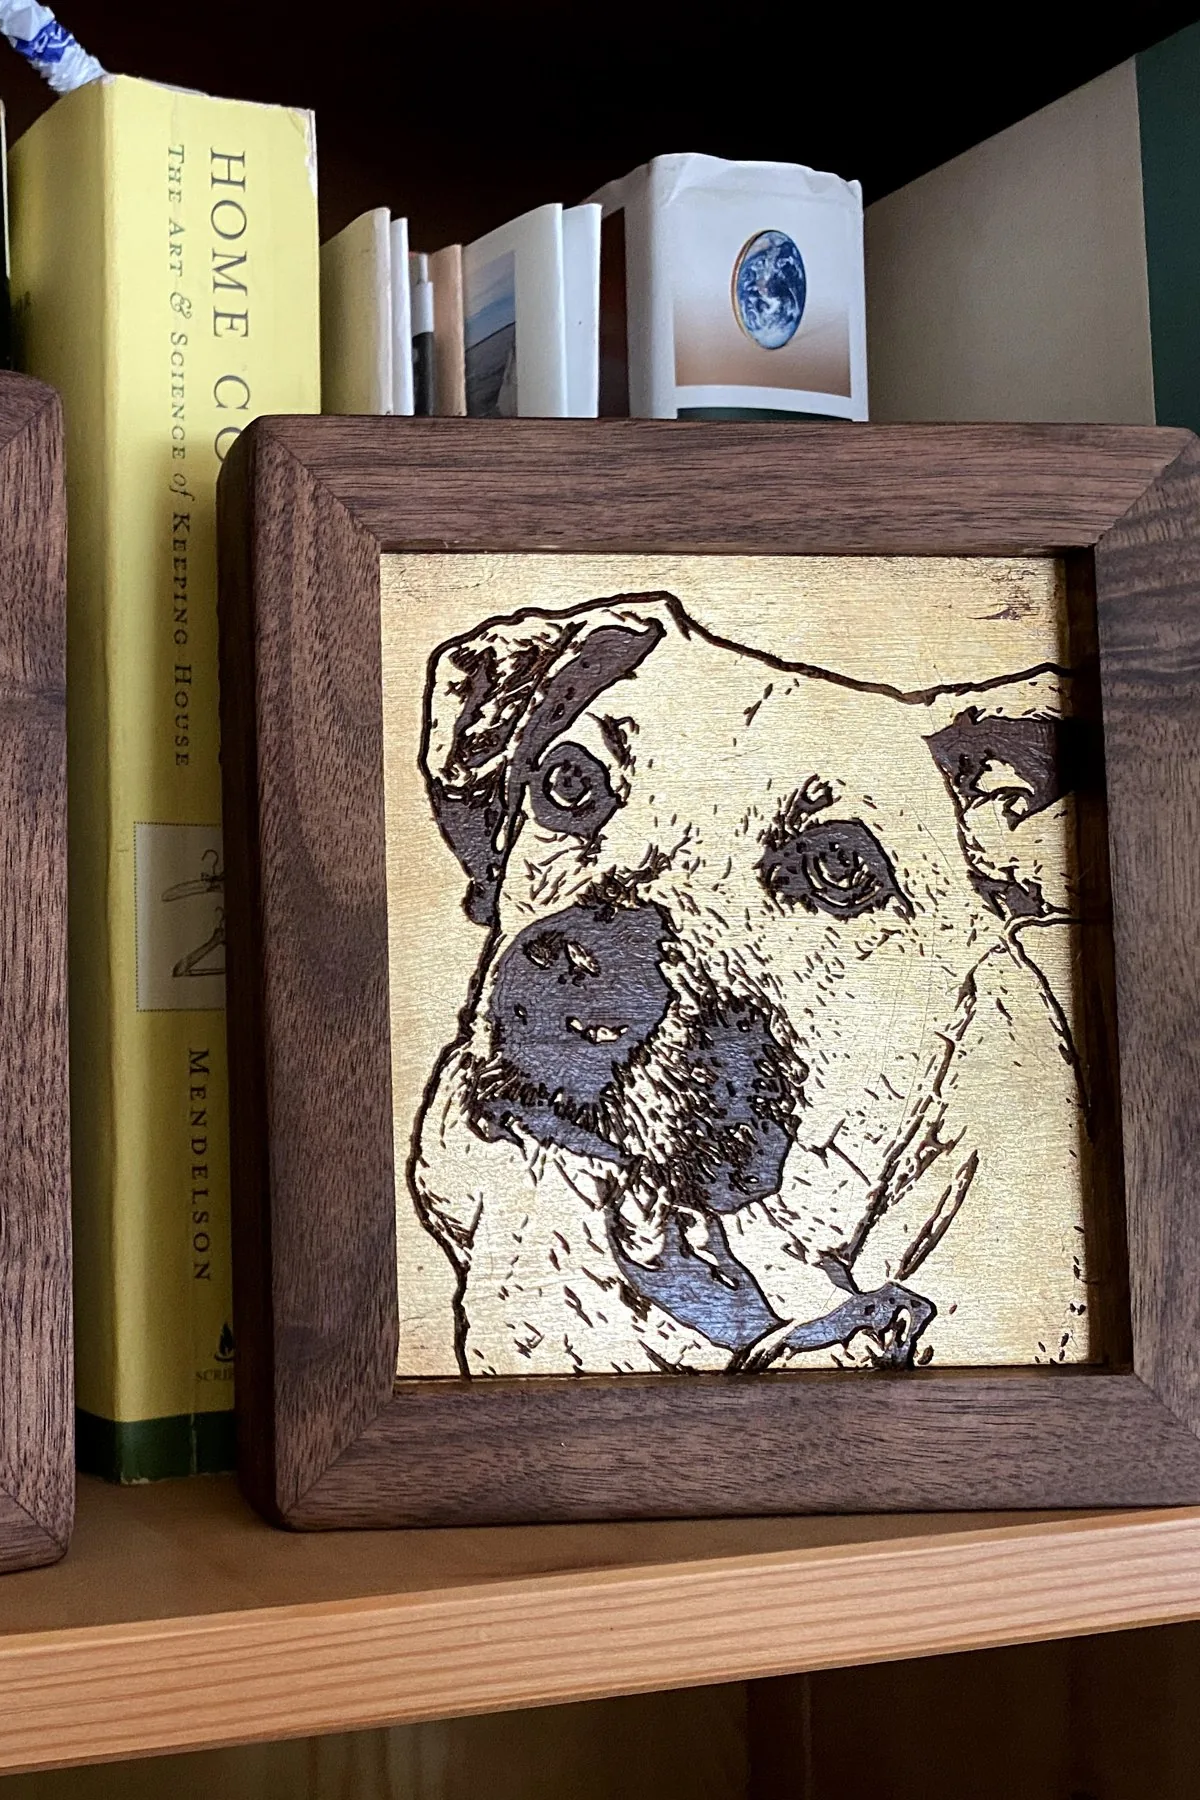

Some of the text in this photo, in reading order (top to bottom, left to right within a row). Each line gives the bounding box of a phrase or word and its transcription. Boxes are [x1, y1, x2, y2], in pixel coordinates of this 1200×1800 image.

[209, 146, 250, 338] HOME
[167, 144, 195, 766] THE ART & SCIENCE of KEEPING HOUSE
[187, 1048, 212, 1281] MENDELSON
